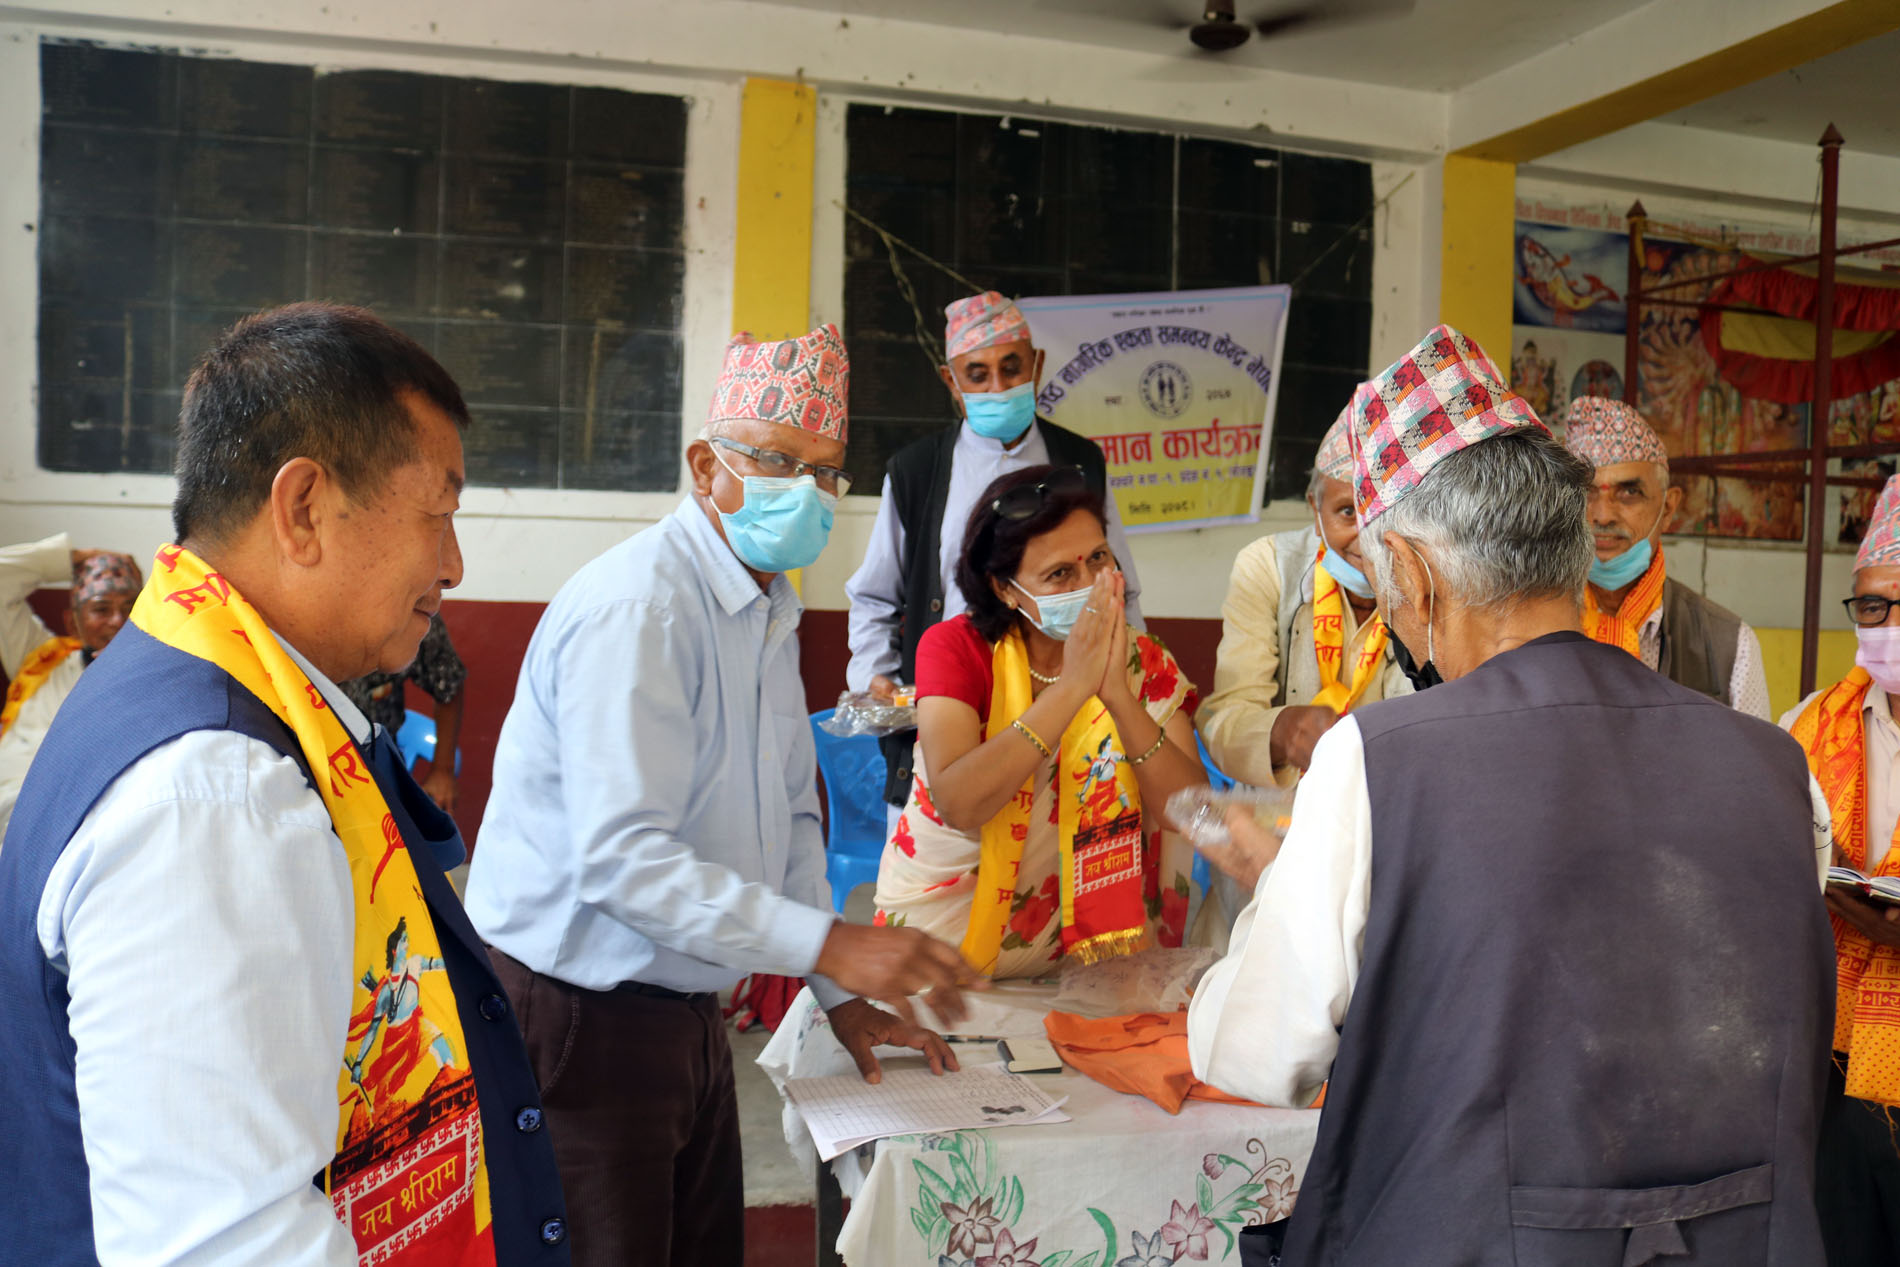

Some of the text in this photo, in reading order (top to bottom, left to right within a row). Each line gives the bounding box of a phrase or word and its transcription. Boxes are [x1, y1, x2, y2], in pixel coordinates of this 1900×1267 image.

[1056, 337, 1114, 385] नागरिक
[1113, 326, 1153, 352] एकता
[1156, 325, 1211, 350] समन्वय
[1089, 432, 1152, 466] मान
[1313, 614, 1342, 633] जय
[1085, 851, 1131, 877] जय श्रीराम
[359, 1156, 458, 1236] जय श्रीराम
